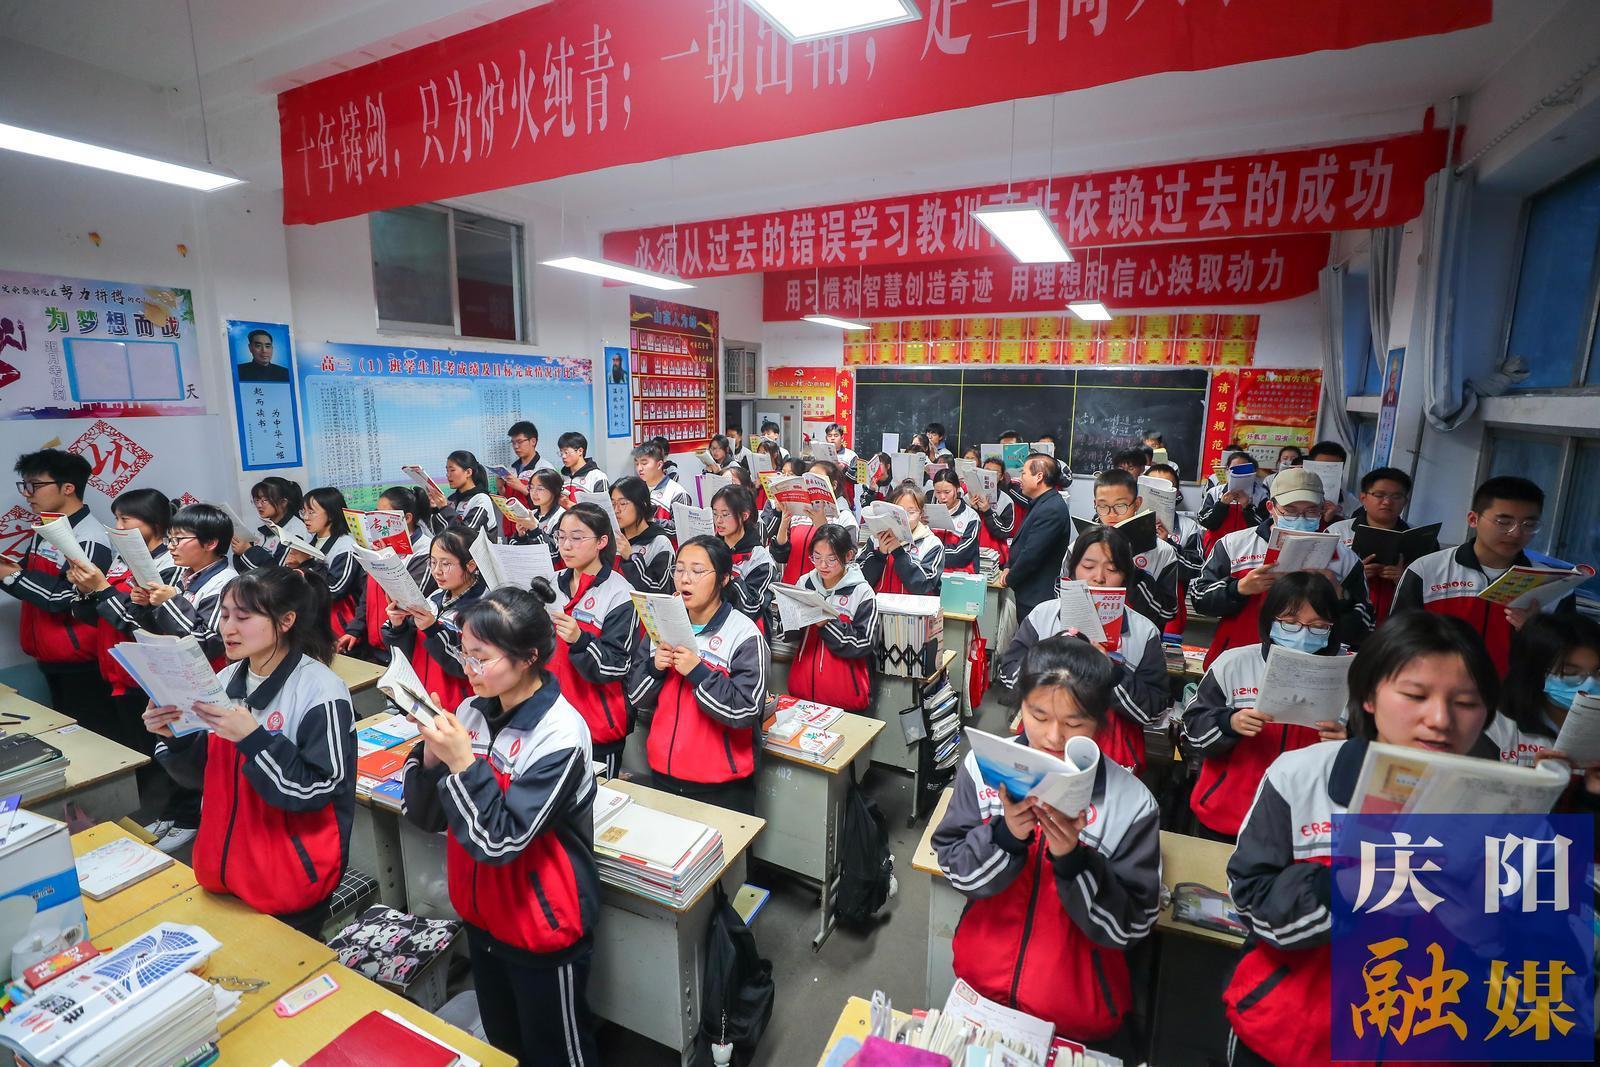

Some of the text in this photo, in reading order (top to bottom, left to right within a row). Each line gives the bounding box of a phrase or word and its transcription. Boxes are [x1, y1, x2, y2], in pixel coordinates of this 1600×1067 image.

[785, 248, 1285, 312] 用习惯和智慧创造奇迹 用理想和信心换取动力
[44, 306, 181, 338] 为梦想而战
[187, 384, 200, 401] 天
